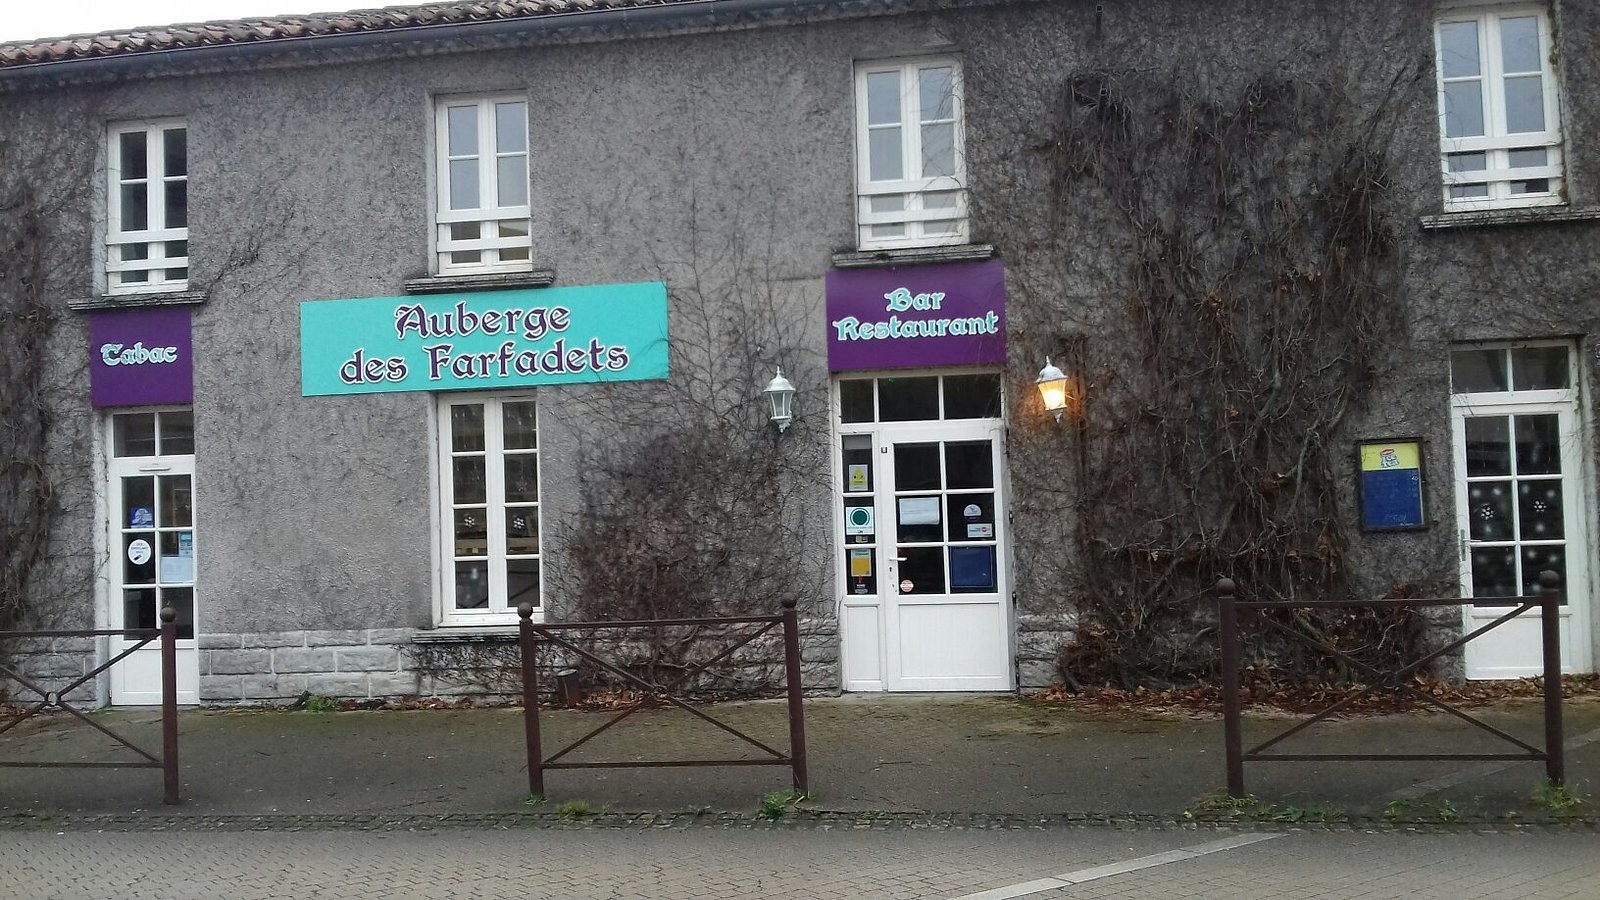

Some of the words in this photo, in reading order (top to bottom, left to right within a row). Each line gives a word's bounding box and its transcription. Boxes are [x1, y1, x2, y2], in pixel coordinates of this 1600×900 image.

[884, 287, 945, 312] Bar
[394, 301, 571, 341] Auberge
[832, 310, 999, 341] Restaurant
[100, 341, 178, 366] Tabac
[339, 348, 409, 384] des
[422, 337, 630, 381] Farfadets
